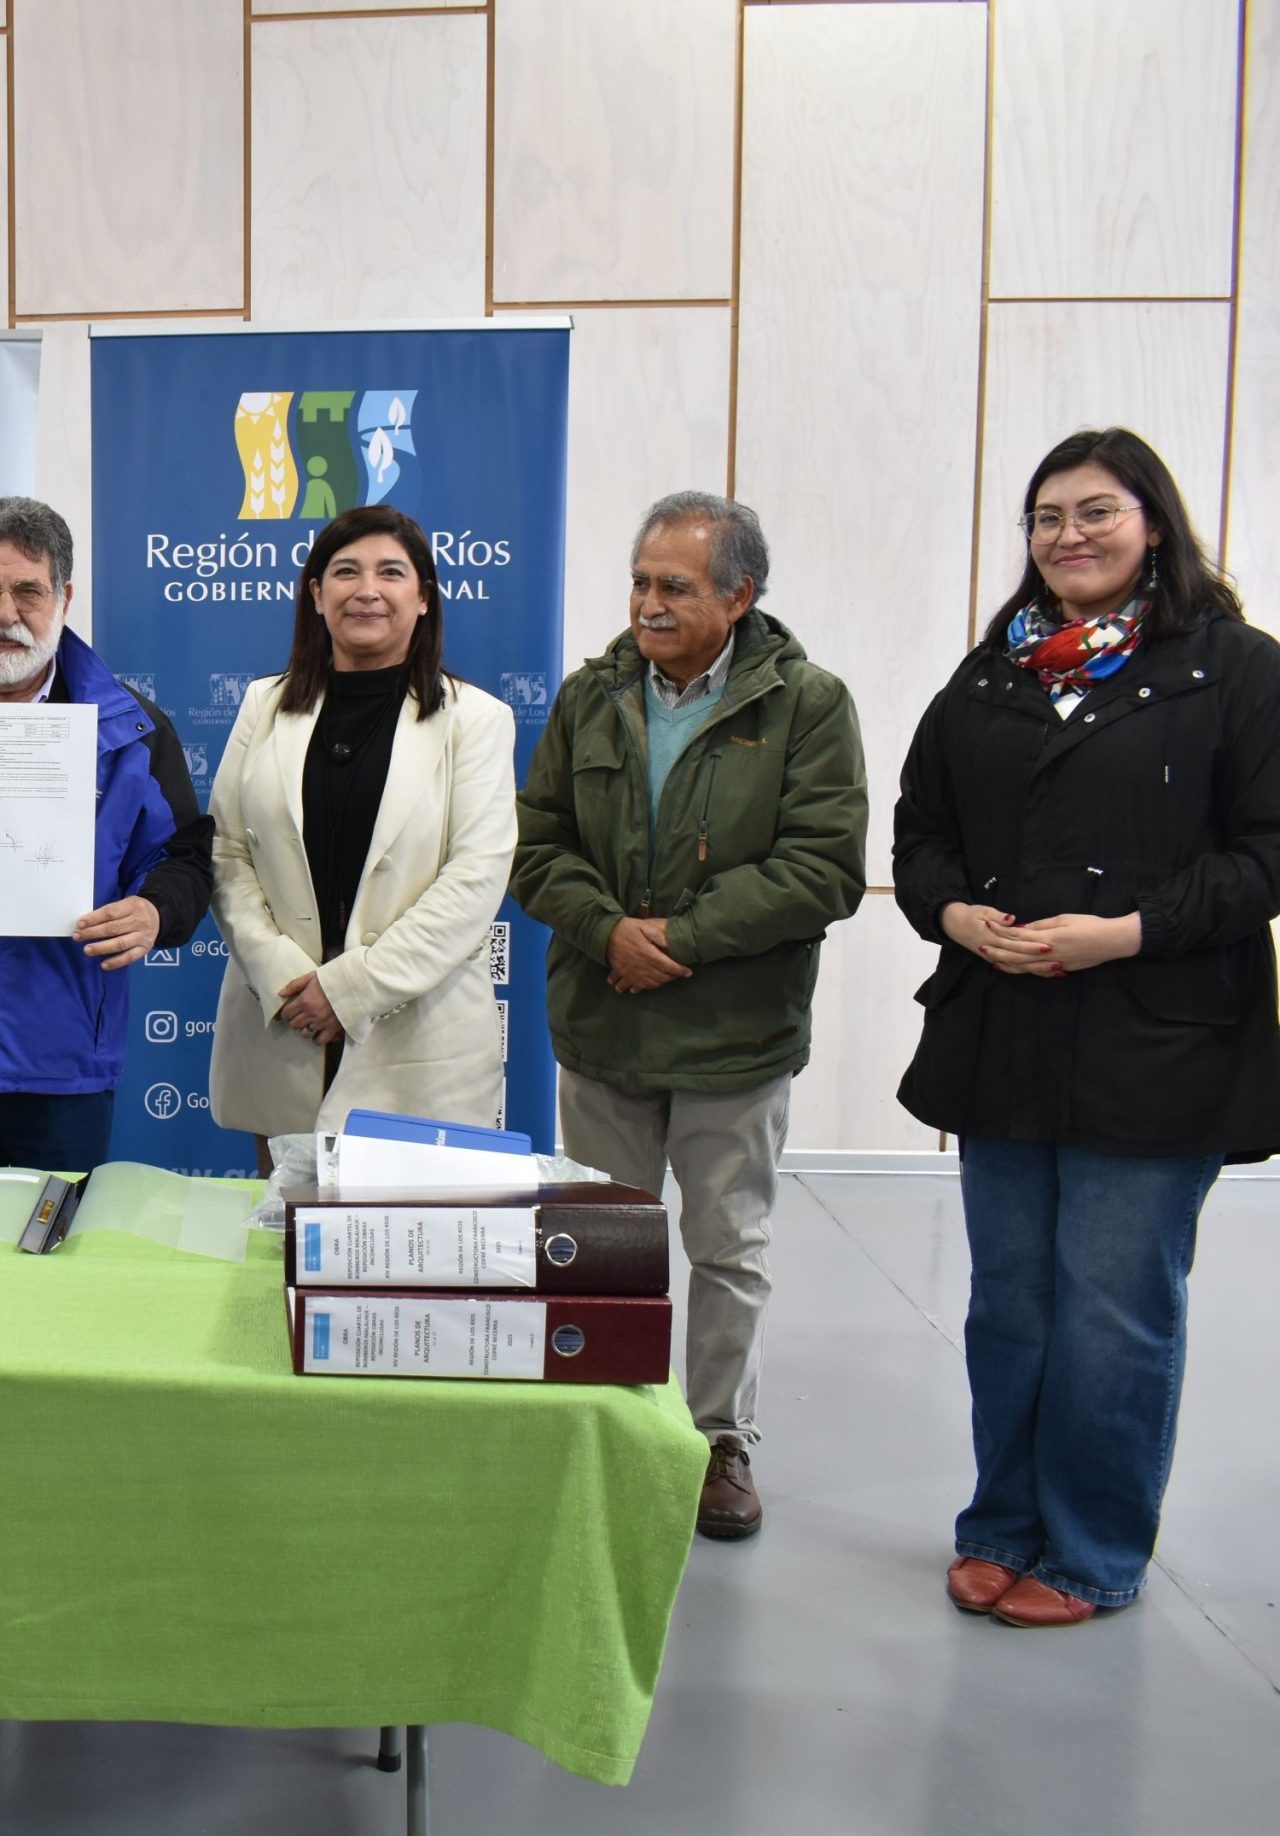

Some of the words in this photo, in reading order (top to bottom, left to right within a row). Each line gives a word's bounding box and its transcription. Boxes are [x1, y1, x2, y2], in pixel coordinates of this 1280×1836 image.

[146, 531, 277, 578] Región
[291, 530, 315, 567] d
[431, 530, 511, 566] Ríos
[164, 581, 294, 602] GOBIERN
[188, 707, 222, 719] Región
[408, 1229, 414, 1238] DE
[415, 1320, 421, 1329] DE
